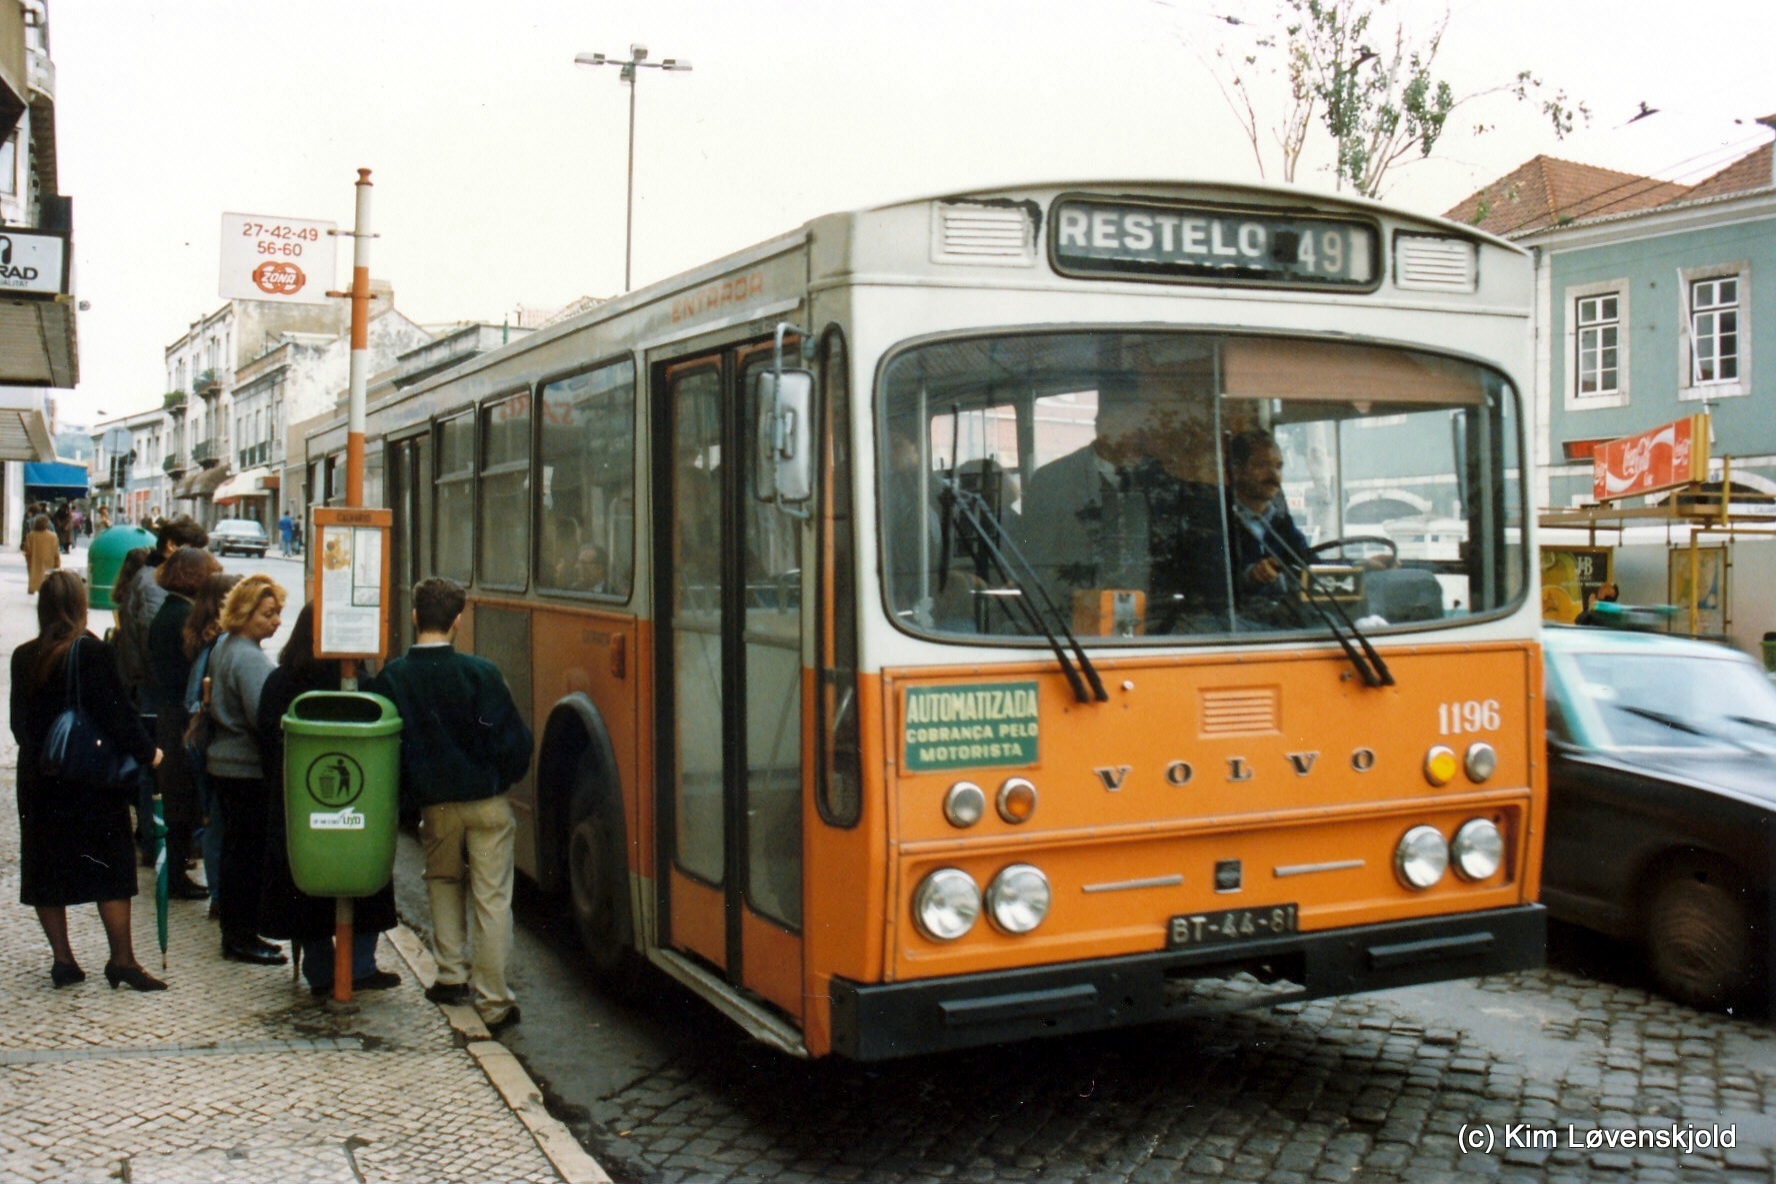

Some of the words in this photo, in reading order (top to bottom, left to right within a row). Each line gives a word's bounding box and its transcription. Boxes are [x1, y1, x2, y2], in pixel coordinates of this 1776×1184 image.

[242, 222, 319, 241] 27-42-49
[257, 240, 303, 257] 56-60
[1059, 208, 1267, 257] RESTELO
[906, 689, 1038, 723] AUTOMATIZADA
[1438, 699, 1500, 736] 1196
[999, 722, 1038, 738] PELO
[919, 742, 1023, 762] MOTORISTA
[1094, 747, 1377, 792] VOLVO
[1172, 905, 1295, 943] BT-44-81
